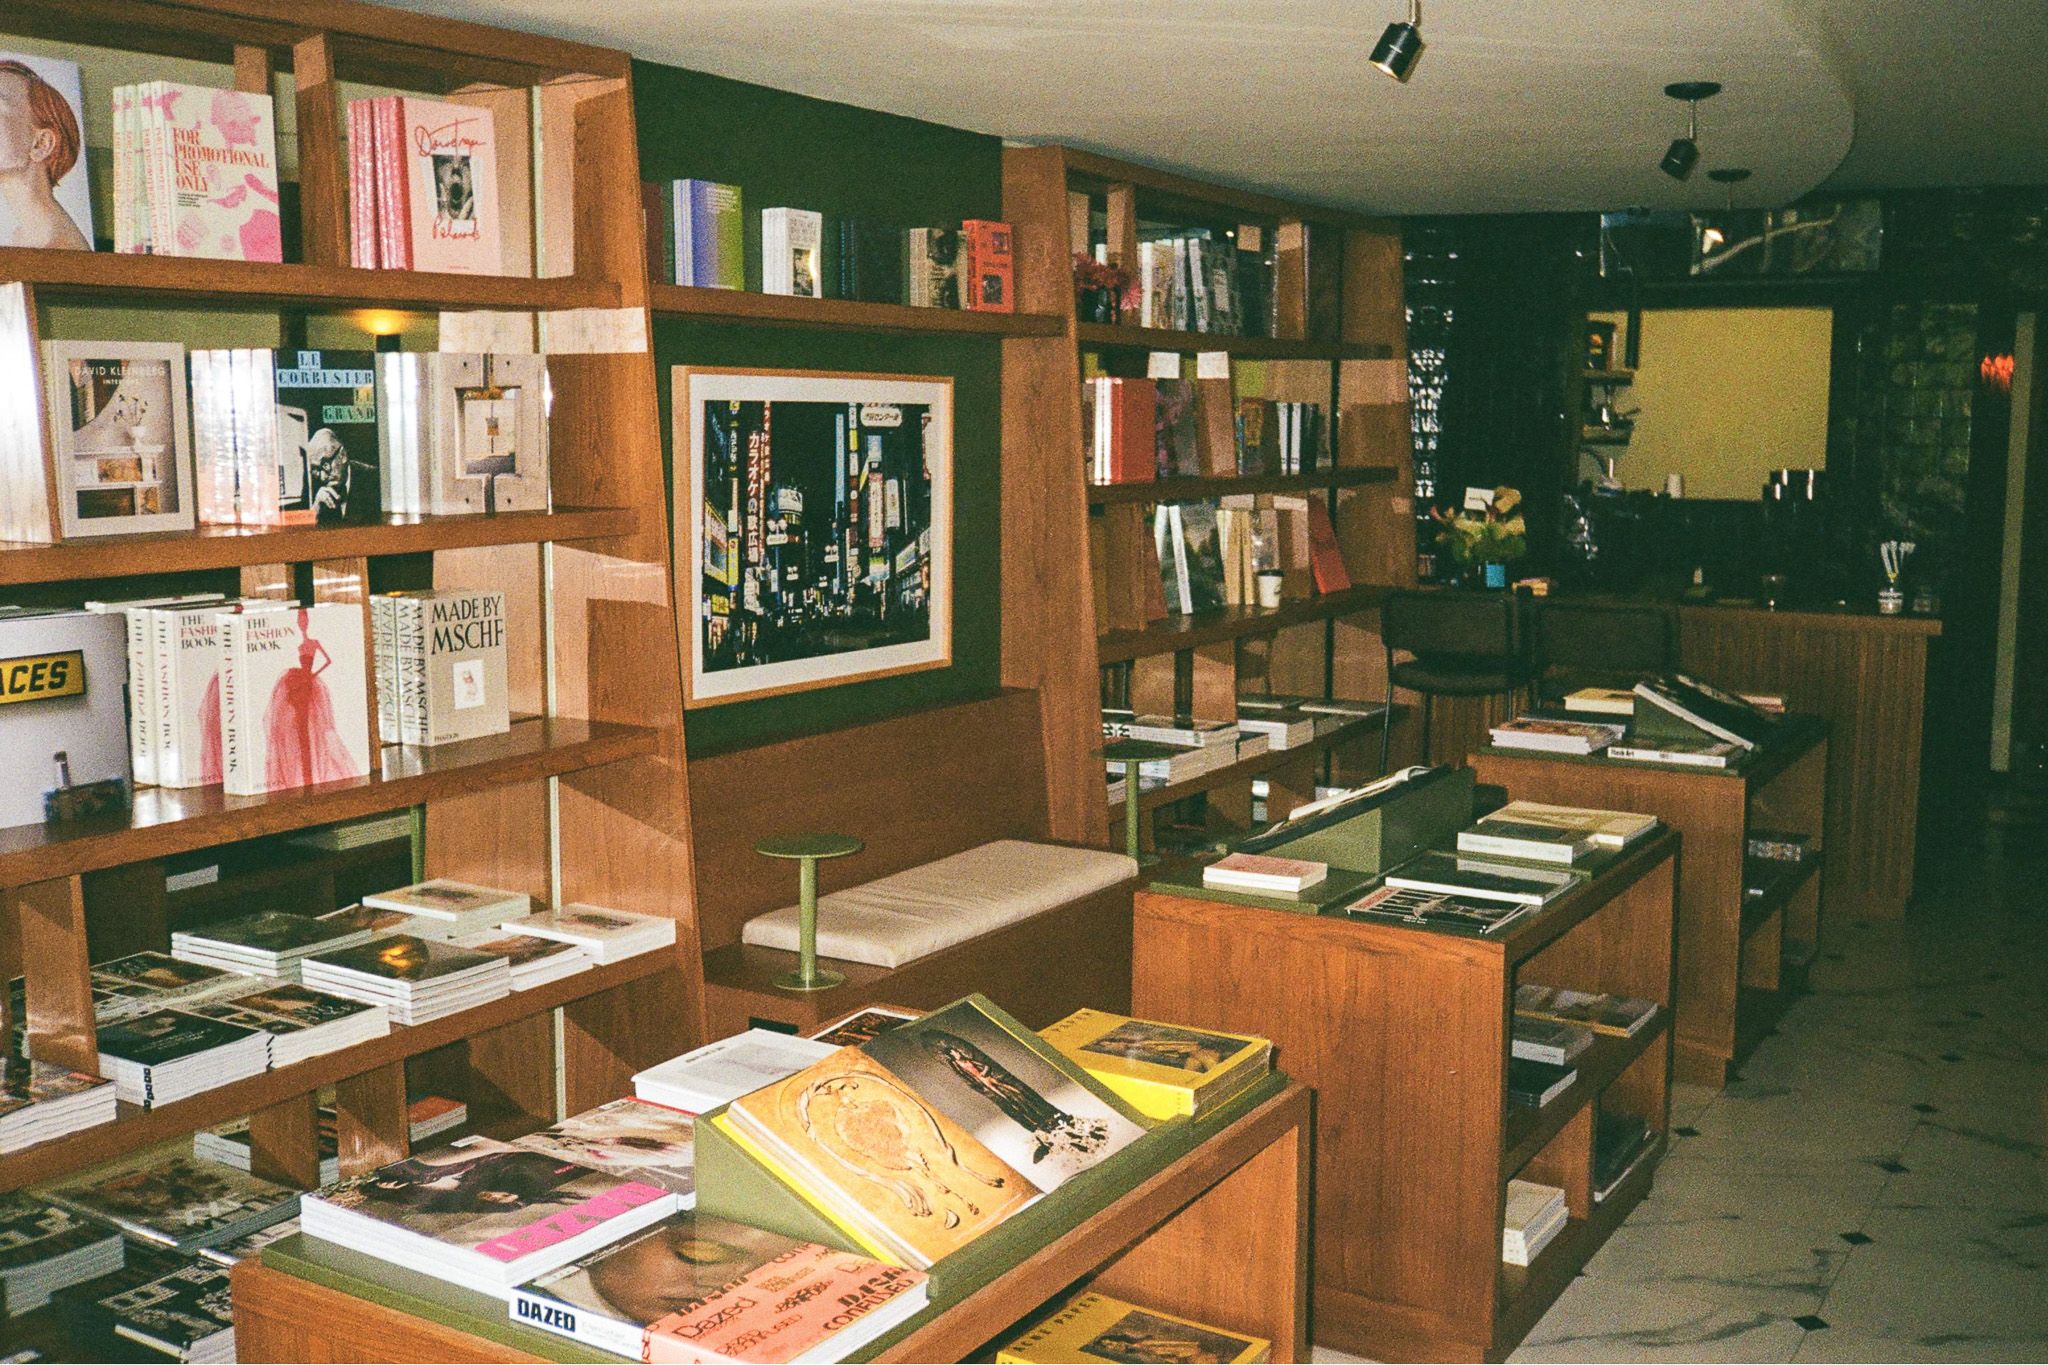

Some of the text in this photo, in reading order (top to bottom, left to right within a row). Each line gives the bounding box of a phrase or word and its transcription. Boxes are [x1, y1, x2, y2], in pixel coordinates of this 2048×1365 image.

[173, 127, 200, 145] FOR
[175, 143, 270, 168] PROMOTIONAL
[175, 159, 199, 174] USE
[176, 176, 208, 192] ONLY
[300, 352, 320, 367] LE
[323, 406, 375, 420] GRAND
[431, 595, 501, 624] MADE BY
[181, 614, 204, 627] THE
[246, 618, 267, 630] THE
[247, 625, 296, 642] FASHION
[431, 619, 503, 655] MSCHF
[181, 637, 217, 650] BOOK
[247, 640, 280, 654] BOOK
[0, 661, 69, 696] CES
[225, 658, 235, 724] FASHION
[228, 729, 238, 773] BOOK
[517, 1298, 575, 1333] DAZED
[671, 1297, 757, 1338] Dazed
